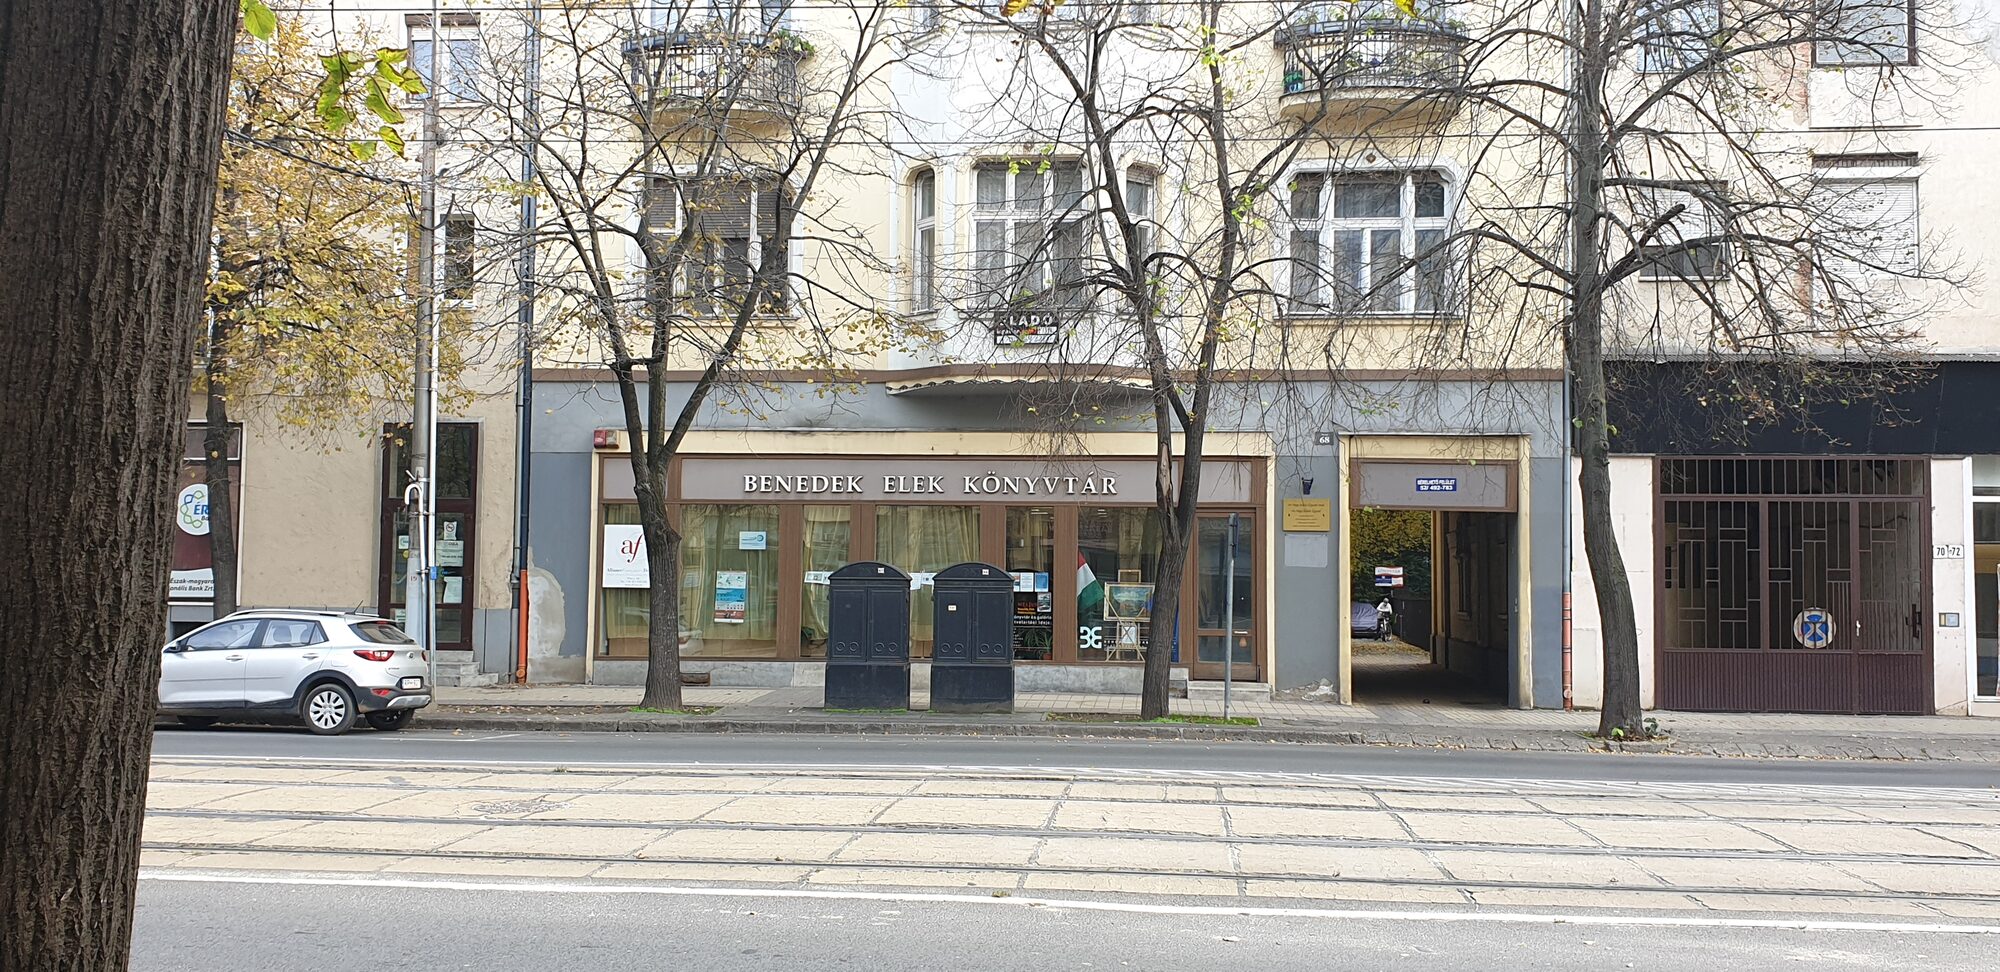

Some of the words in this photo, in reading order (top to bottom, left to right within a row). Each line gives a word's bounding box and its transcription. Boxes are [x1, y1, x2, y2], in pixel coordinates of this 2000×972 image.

[1000, 313, 1053, 327] LADÓ
[1319, 436, 1330, 444] 68
[744, 475, 864, 493] BENEDEK
[883, 475, 945, 493] ELEK
[964, 471, 1118, 494] KÖNYVTÁR
[621, 534, 643, 563] af
